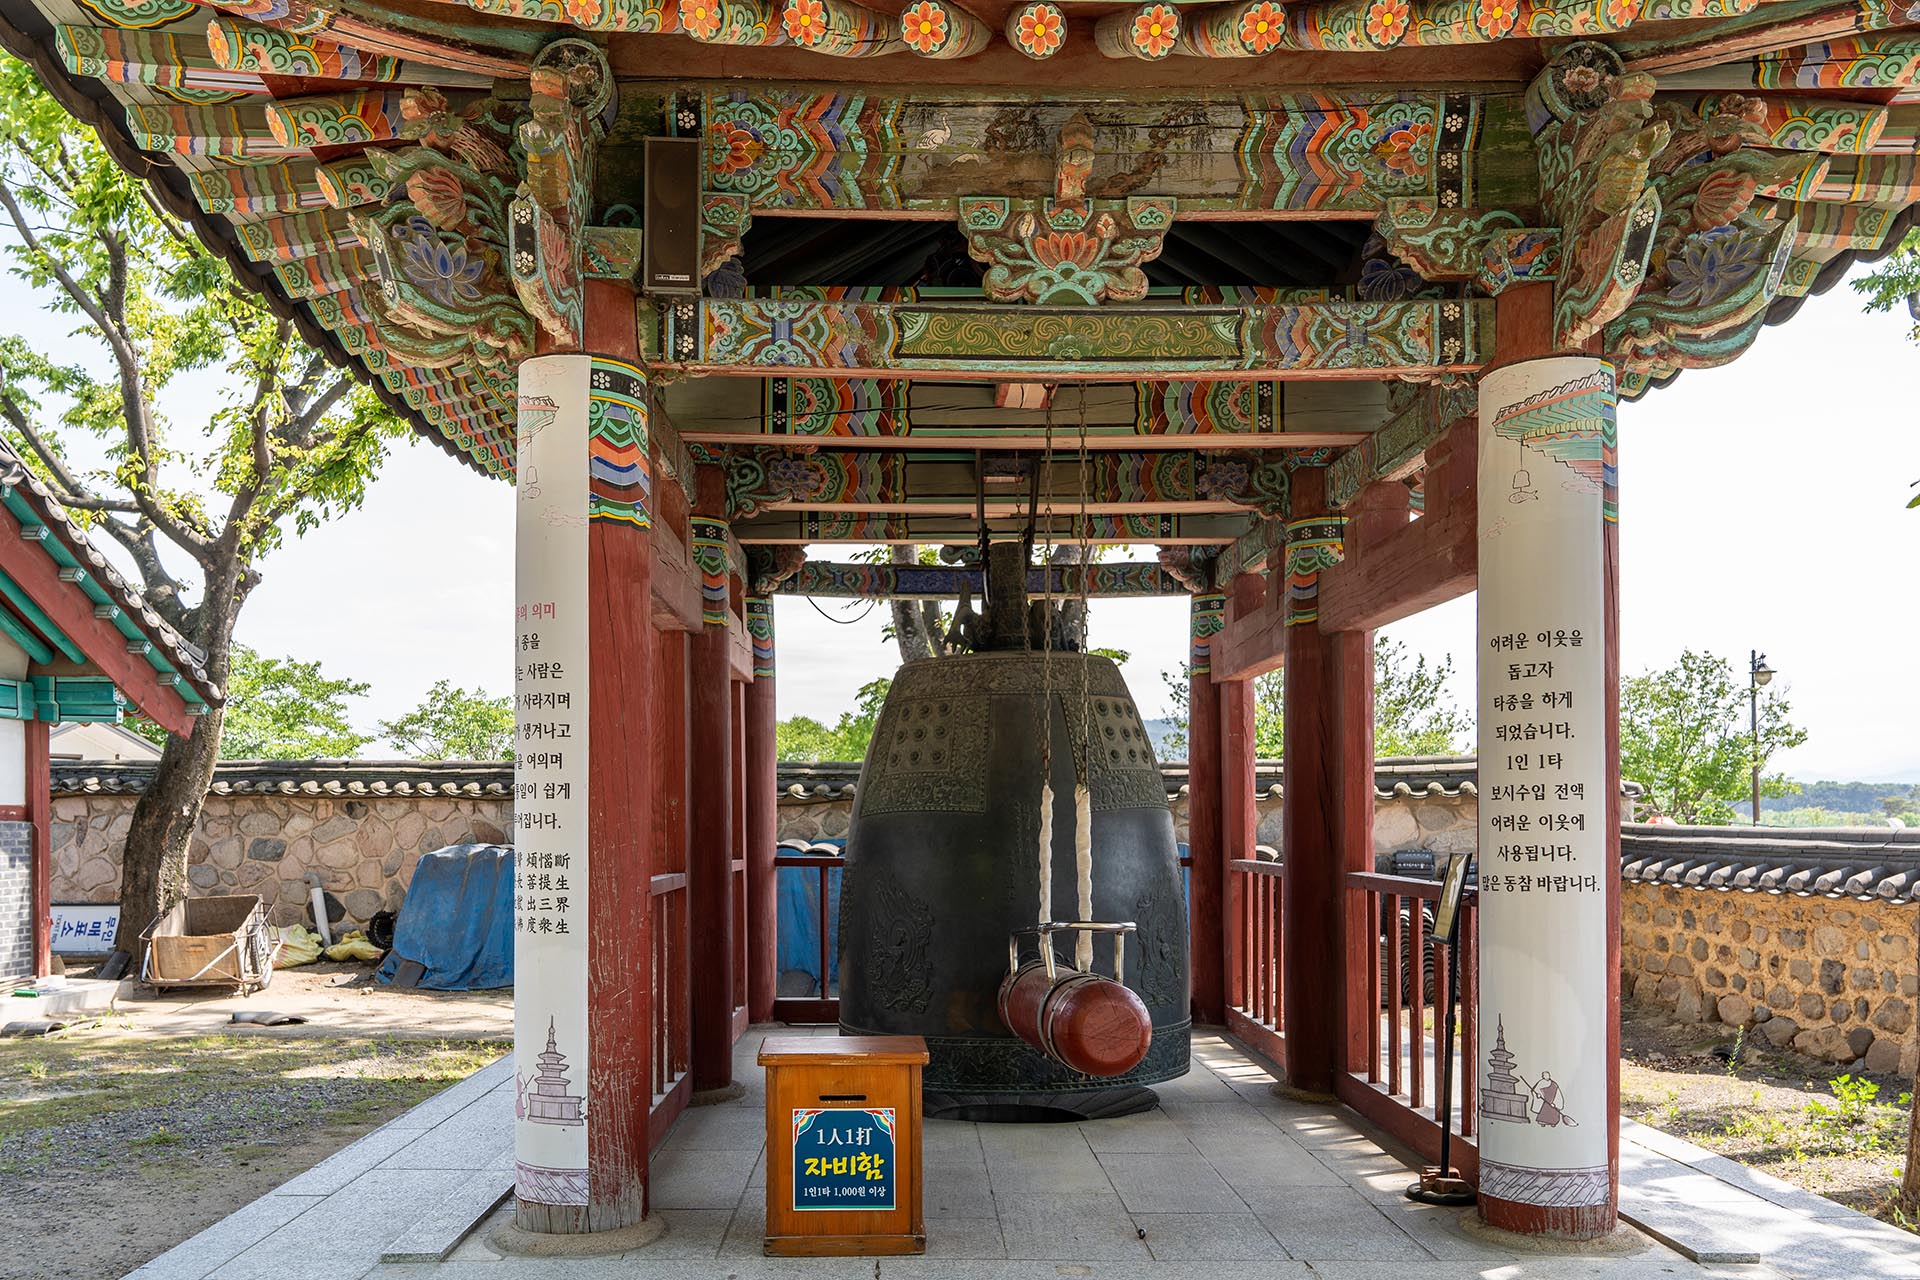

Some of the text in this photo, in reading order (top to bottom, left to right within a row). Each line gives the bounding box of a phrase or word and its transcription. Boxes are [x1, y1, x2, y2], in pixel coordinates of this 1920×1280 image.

[532, 602, 556, 619] 의미
[521, 633, 540, 651] 종을
[1490, 630, 1583, 652] 어려운 이웃을
[526, 662, 564, 680] 사람은
[1508, 661, 1554, 681] 돕고자
[522, 692, 571, 710] 사라지며
[1493, 691, 1573, 712] 타종을 하게
[522, 722, 571, 740] 생겨나고
[1495, 722, 1575, 742] 되었습니다.
[526, 752, 563, 770] 여의며
[1507, 753, 1563, 771] 1인 1타
[543, 782, 571, 800] 쉽게
[1491, 783, 1584, 801] 보시수입 전액
[1491, 813, 1585, 832] 어려운 이웃에
[1496, 844, 1577, 862] 사용됩니다.
[1482, 875, 1601, 893] 많은 동참 바랍니다.
[816, 1127, 873, 1146] 1人1打
[804, 1151, 885, 1181] 자비함
[868, 1186, 887, 1198] 이상
